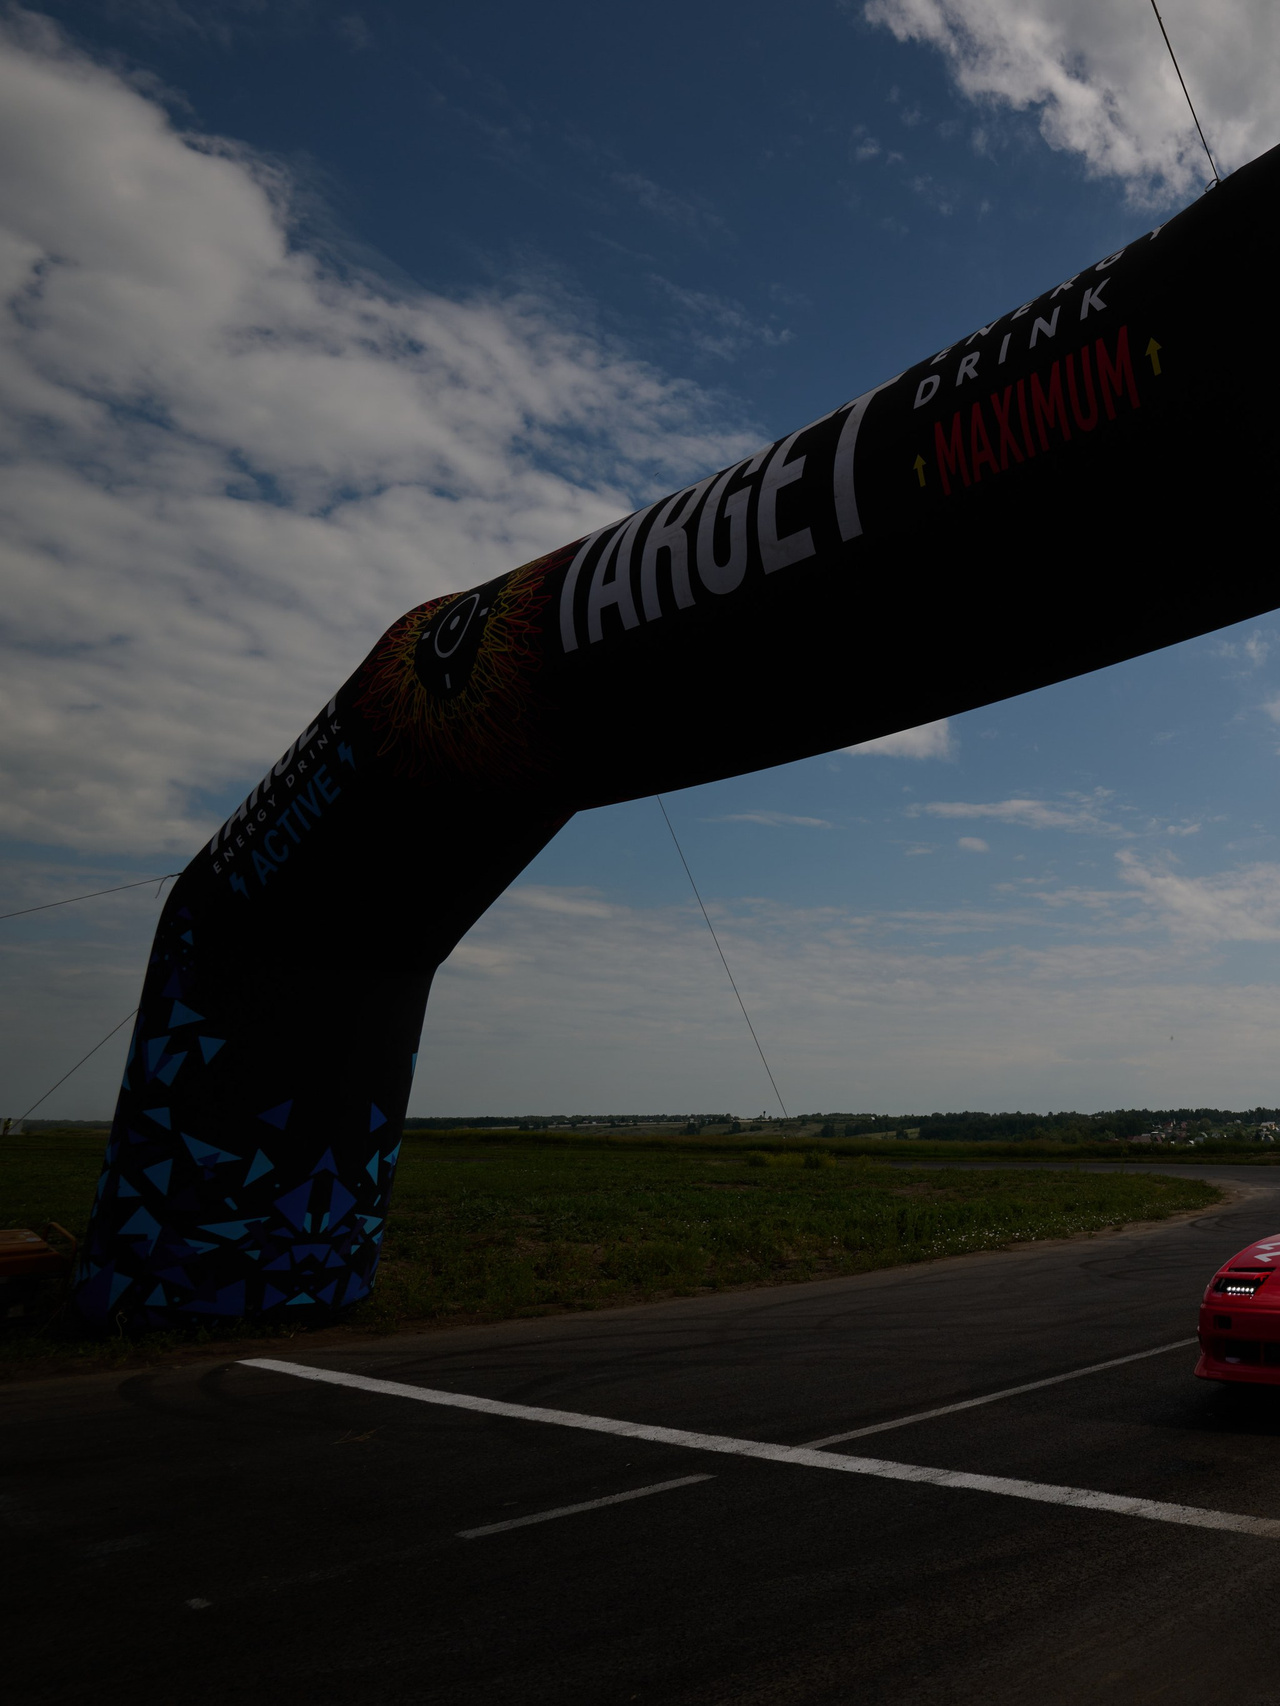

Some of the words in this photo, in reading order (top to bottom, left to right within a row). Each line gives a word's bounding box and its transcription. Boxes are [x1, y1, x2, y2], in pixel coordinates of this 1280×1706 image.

[913, 276, 1111, 410] DRINK
[933, 322, 1142, 497] MAXIMUM
[558, 370, 908, 654] TARGET
[213, 794, 277, 875] ENERGY
[285, 719, 342, 788] DRINK
[250, 763, 342, 887] ACTIVE
